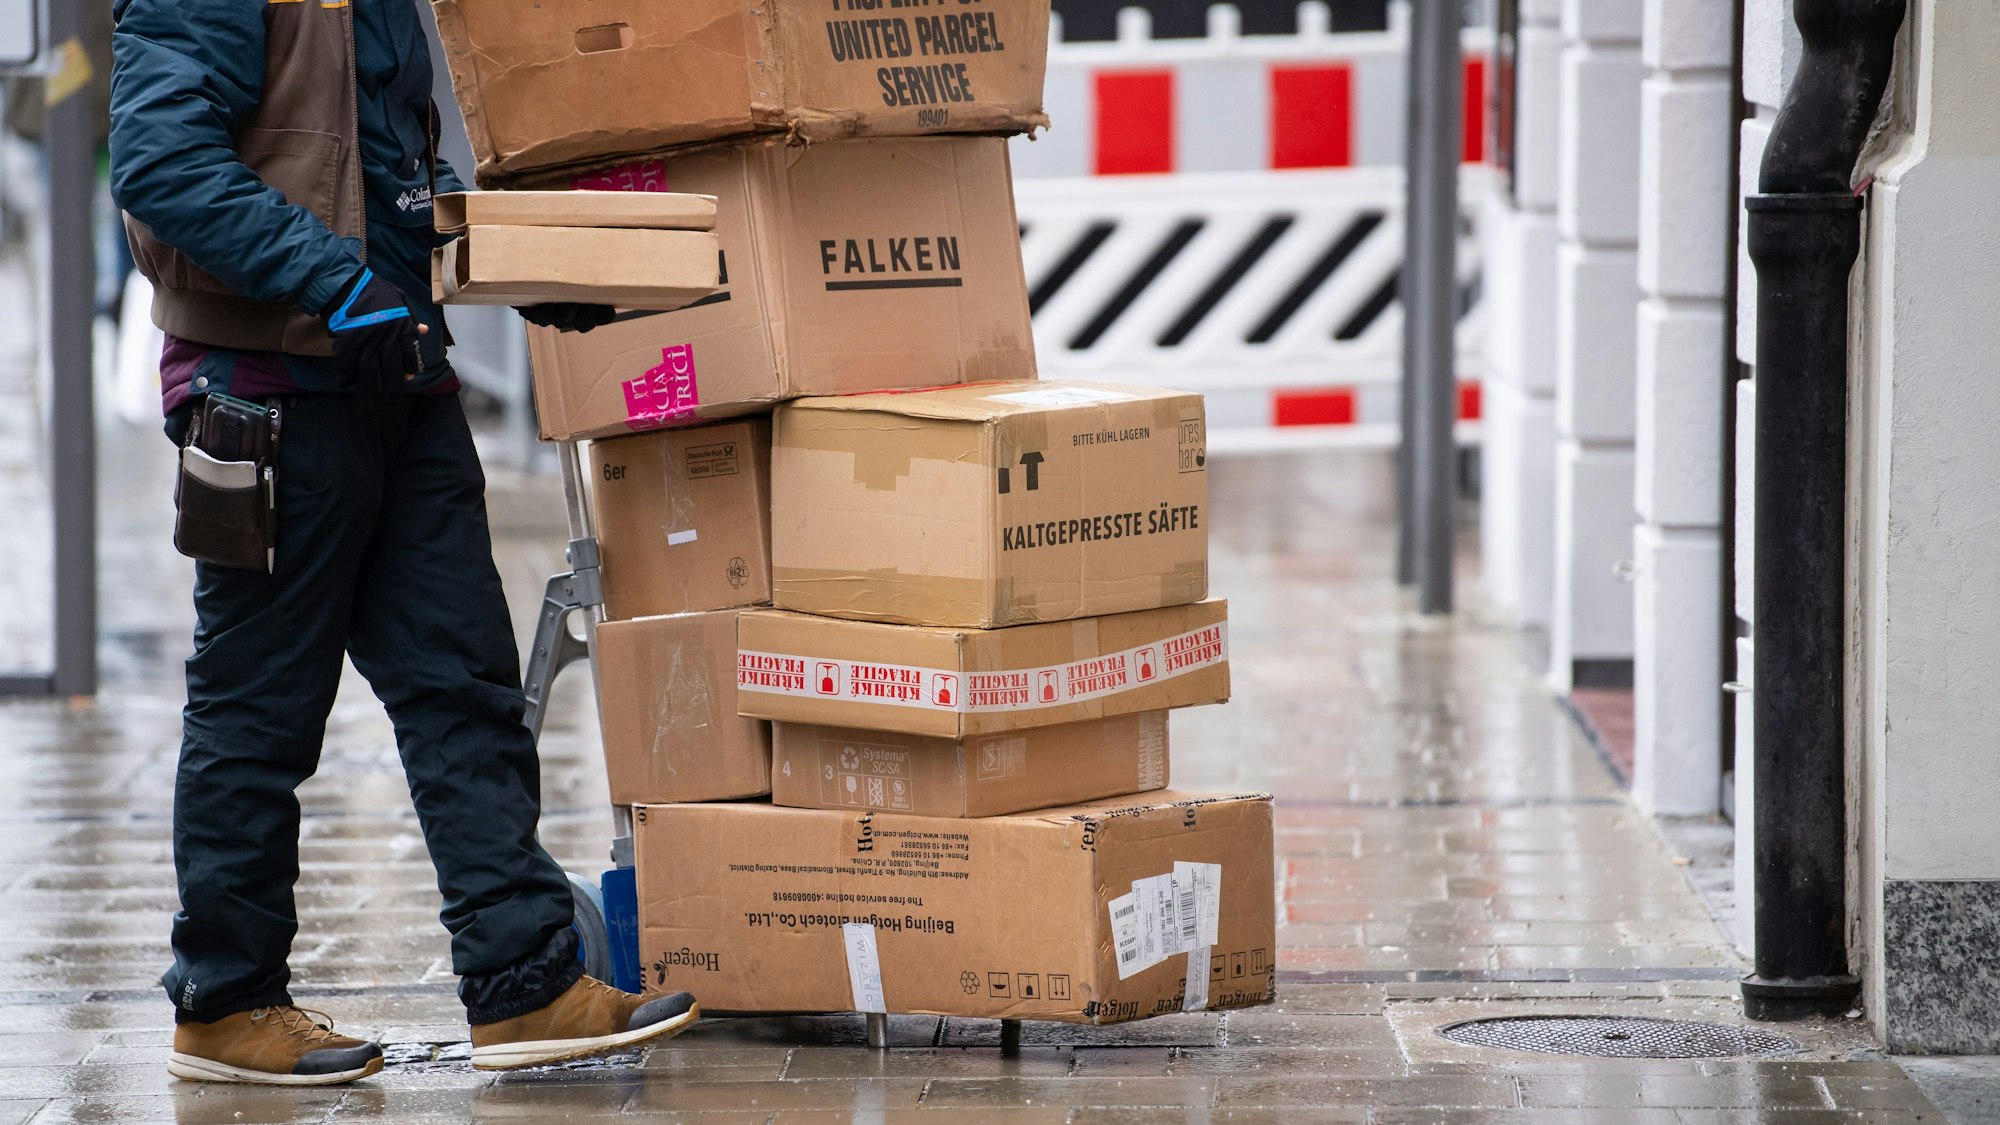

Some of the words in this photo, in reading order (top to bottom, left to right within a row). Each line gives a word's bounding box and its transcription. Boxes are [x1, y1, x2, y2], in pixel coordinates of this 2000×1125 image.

[826, 18, 913, 62] UNITED
[914, 12, 1005, 56] PARCEL
[877, 62, 976, 107] SERVICE
[819, 236, 961, 274] FALKEN
[1073, 432, 1095, 446] BITTE
[1096, 428, 1118, 444] KÜHL
[1119, 427, 1151, 441] LAGERN
[1178, 422, 1200, 444] pres
[1178, 447, 1196, 470] bar
[603, 462, 627, 481] 6er
[1003, 511, 1142, 551] KALTGEPRESSTE
[1149, 502, 1198, 534] SÄFTE
[1163, 626, 1221, 656] FRAGILE
[738, 653, 805, 673] FRAGILE
[1066, 655, 1126, 679] FRAGILE
[1164, 642, 1223, 674] KŘEHKÉ
[850, 664, 921, 684] FRAGILE
[969, 672, 1029, 690] FRAGILE
[1067, 671, 1127, 697] KŘEHKÉ
[850, 681, 921, 702] KŘEHKÉ
[969, 689, 1029, 708] KŘEHKÉ
[783, 761, 792, 777] 4
[824, 764, 834, 780] 3
[872, 760, 901, 775] SC/SA
[940, 833, 969, 841] Website:
[945, 853, 969, 861] Phone:
[826, 893, 854, 903] hotline
[856, 894, 887, 904] service
[889, 896, 906, 906] free
[907, 897, 923, 906] The
[905, 915, 954, 934] Beijing
[663, 947, 720, 972] Hotgen
[857, 940, 873, 1003] WIZARD
